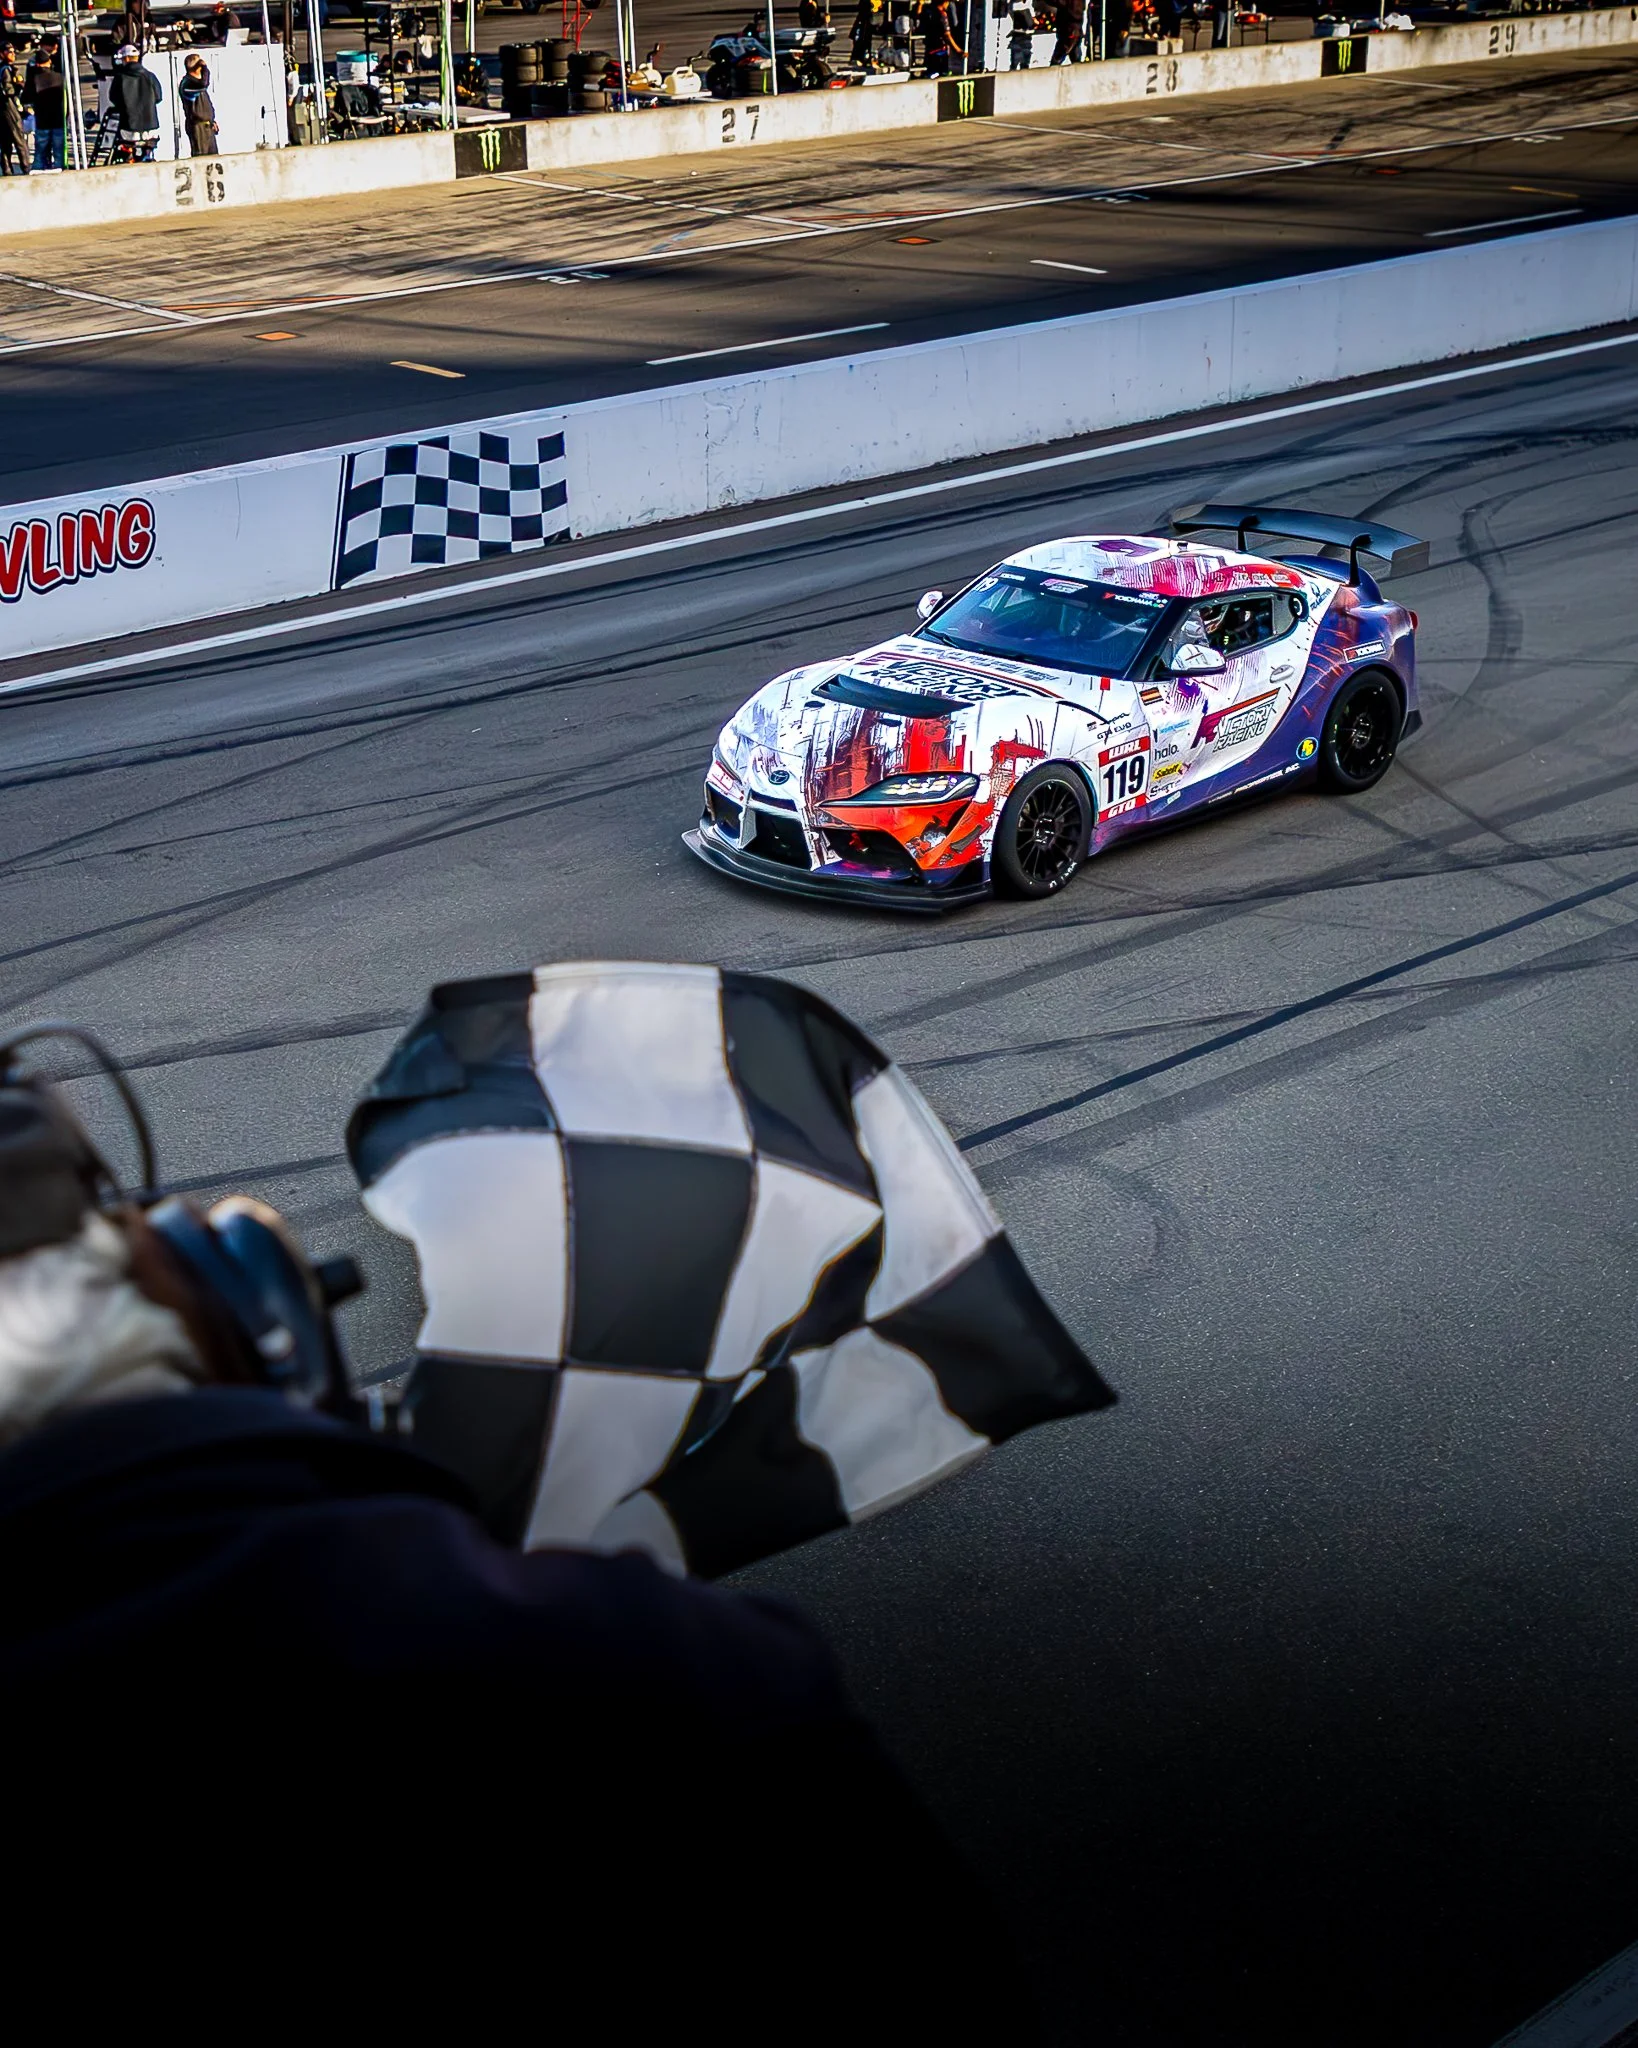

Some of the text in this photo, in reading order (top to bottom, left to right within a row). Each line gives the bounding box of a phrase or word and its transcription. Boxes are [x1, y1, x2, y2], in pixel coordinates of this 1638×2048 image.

[1489, 24, 1515, 54] 29
[1146, 60, 1178, 94] 28
[722, 105, 760, 143] 27
[175, 163, 225, 206] 26
[886, 661, 1032, 698] VICTORY
[1216, 700, 1277, 739] VICTORY
[1103, 755, 1146, 804] 119
